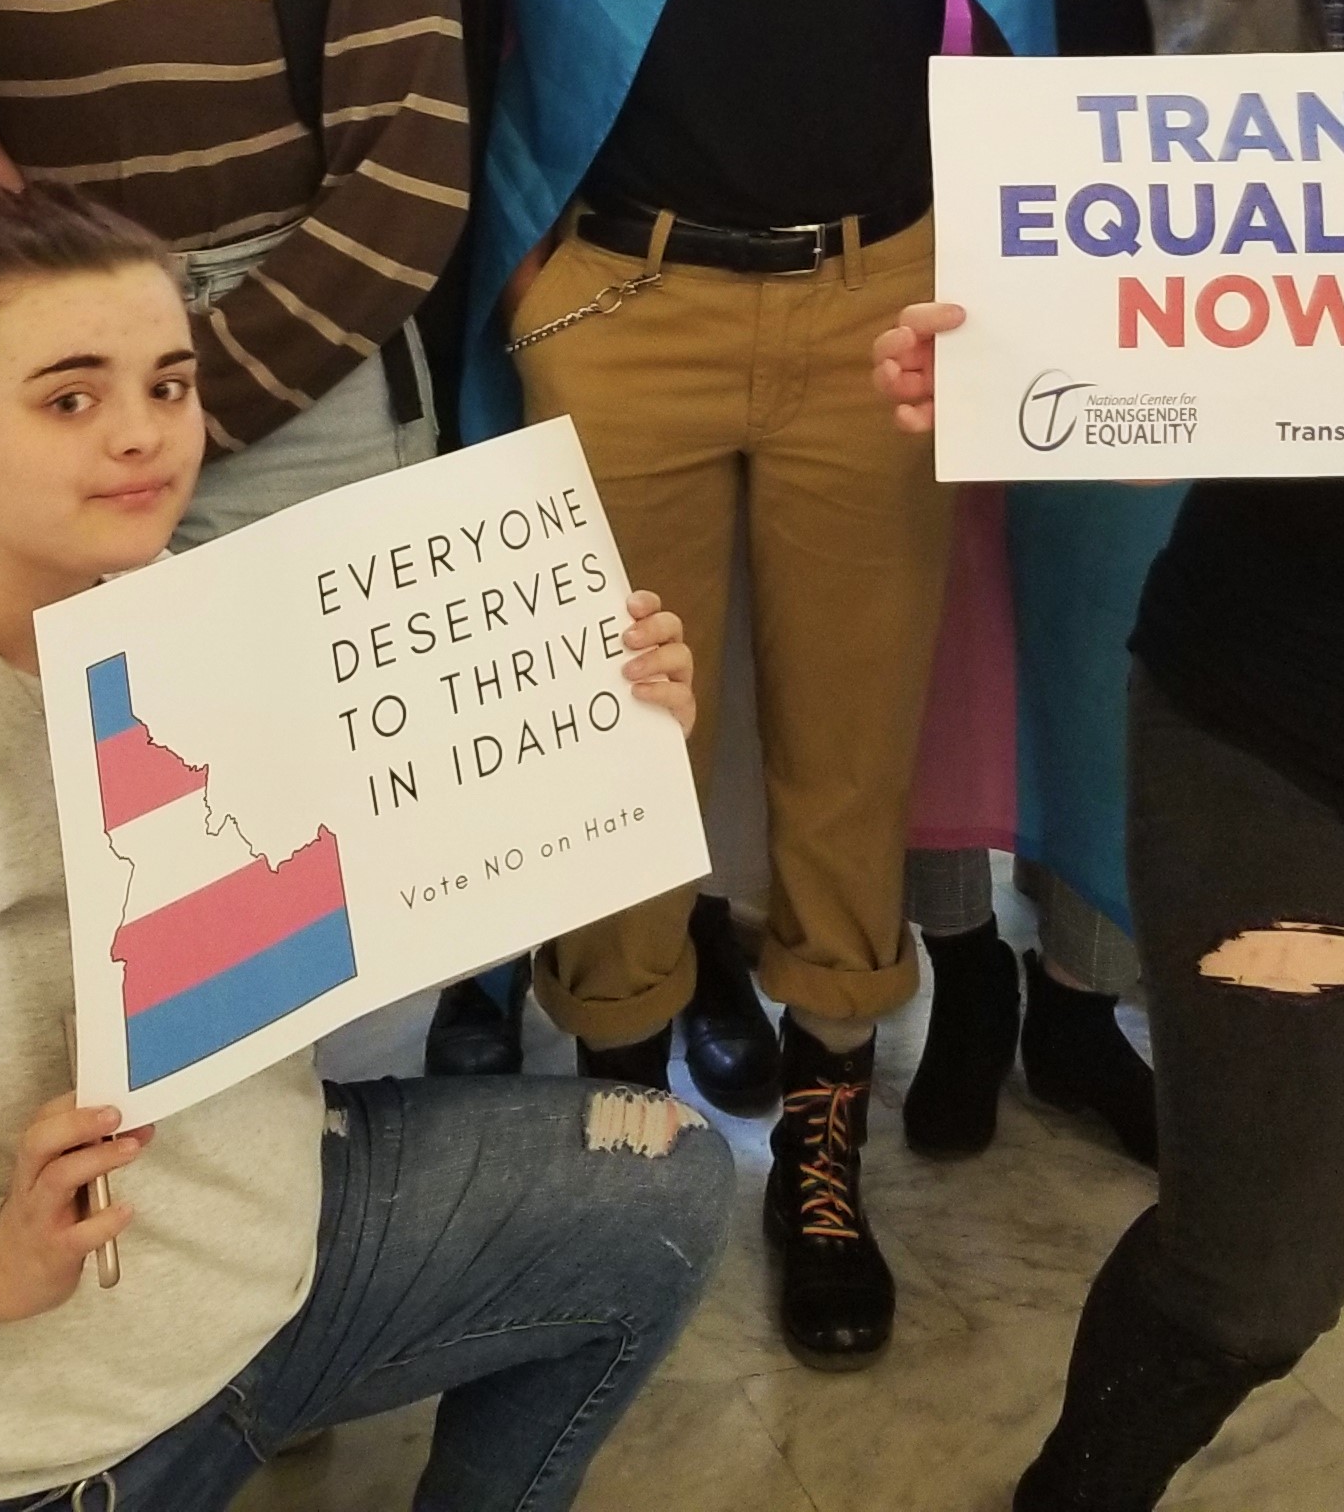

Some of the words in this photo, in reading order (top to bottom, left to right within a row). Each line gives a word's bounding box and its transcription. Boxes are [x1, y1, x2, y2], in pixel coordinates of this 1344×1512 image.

[1084, 407, 1198, 423] TRANSGENDER
[1086, 423, 1198, 447] EQUALITY
[1087, 394, 1139, 406] National
[1140, 394, 1178, 406] Center
[1179, 392, 1197, 407] for
[317, 487, 588, 615] EVERYONE
[332, 553, 607, 684] DESERVES
[339, 694, 407, 751] TO
[439, 615, 625, 715] THRIVE
[369, 761, 419, 816] IN
[453, 690, 621, 786] IDAHO
[399, 870, 469, 910] Vote
[484, 848, 524, 881] NO
[540, 836, 571, 858] on
[584, 806, 646, 841] Hate
